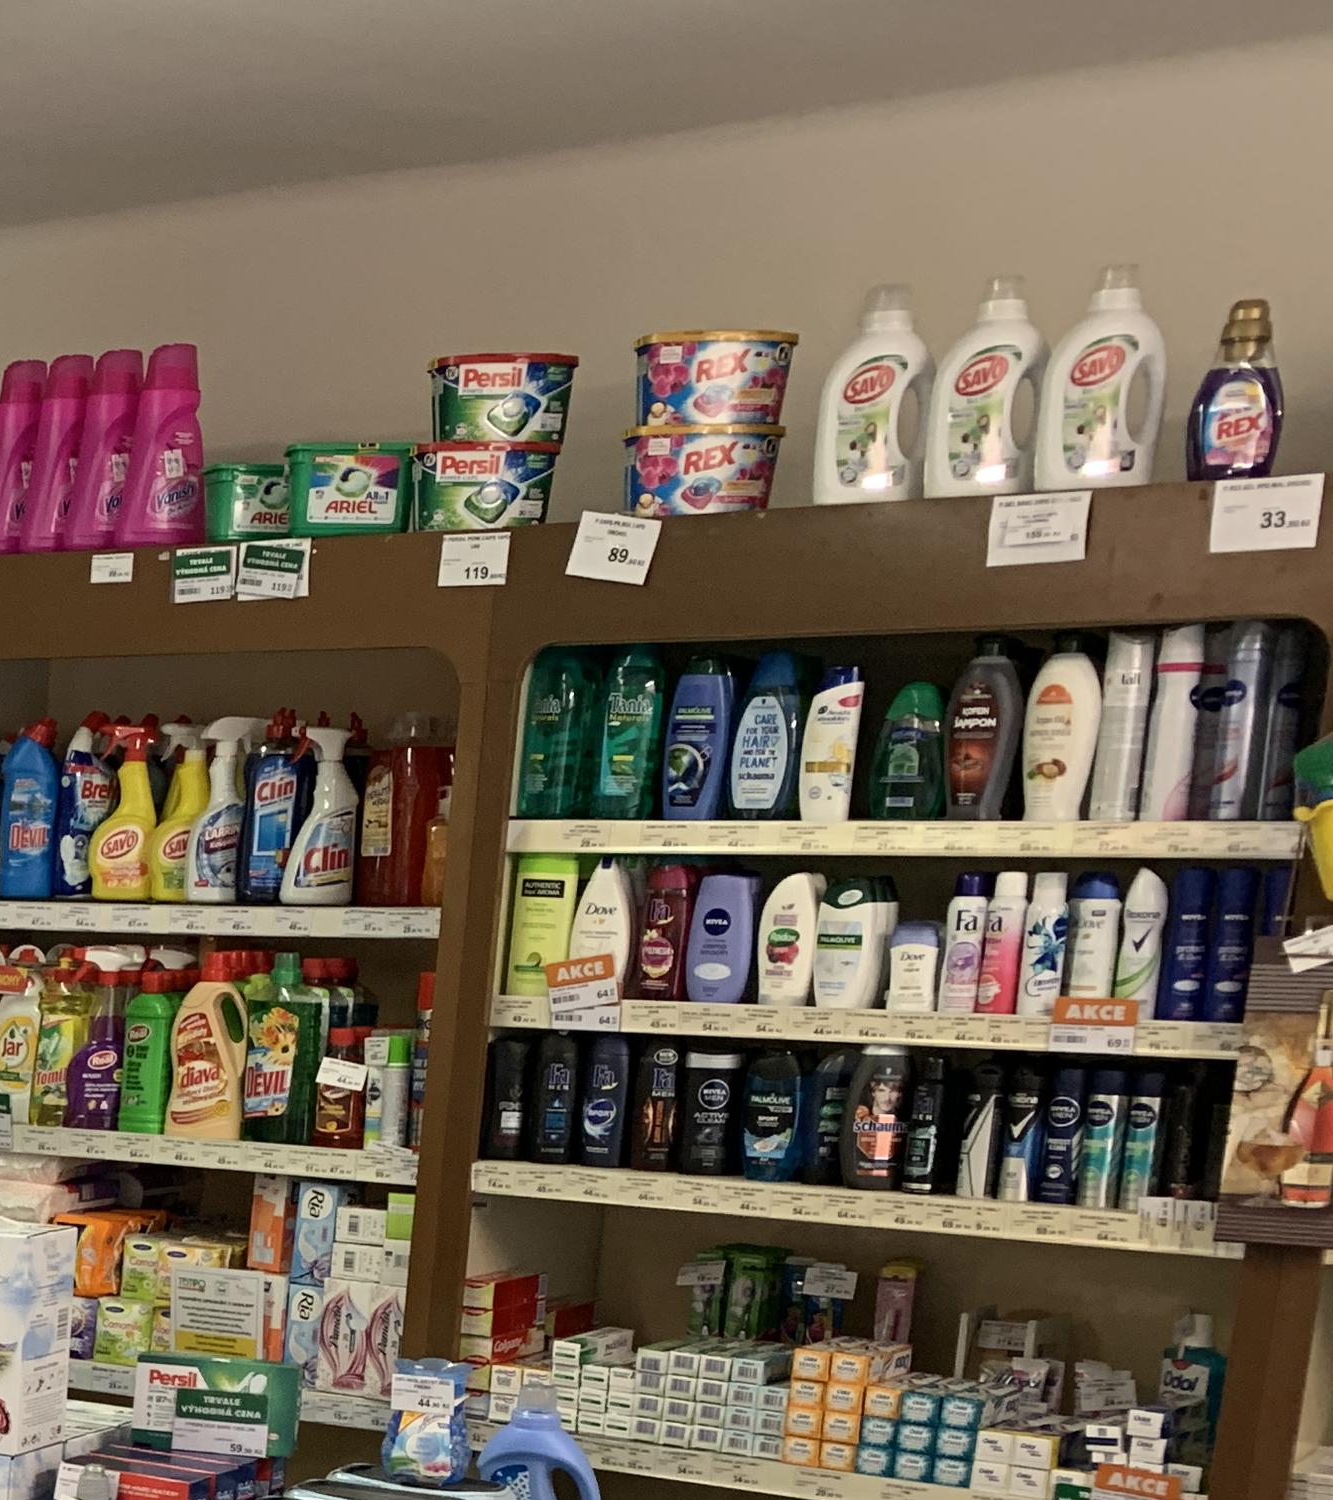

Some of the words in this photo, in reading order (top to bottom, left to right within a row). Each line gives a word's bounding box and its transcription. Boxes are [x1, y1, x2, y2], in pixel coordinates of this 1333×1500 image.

[696, 349, 751, 382] REX
[1079, 349, 1120, 379] SAVO
[463, 366, 523, 389] Persil
[852, 369, 889, 397] SAVO
[963, 361, 1003, 389] SAVO
[1217, 412, 1263, 440] REX
[440, 455, 501, 476] Persil
[683, 441, 739, 475] REX
[157, 480, 198, 505] Vanish
[324, 499, 378, 515] ARIEL
[250, 511, 289, 526] ARIE
[609, 692, 651, 713] Tania
[754, 714, 777, 725] CARE
[741, 736, 769, 748] HAIR
[739, 756, 778, 768] PLANET
[738, 772, 775, 781] schauma
[257, 776, 295, 802] Clin
[104, 832, 138, 853] SAVO
[167, 831, 190, 853] SAV
[304, 843, 349, 874] Clin
[524, 881, 562, 890] AUTHENTIC
[585, 902, 617, 917] Dove
[651, 899, 671, 920] Fa
[705, 918, 729, 926] NIVEA
[955, 909, 978, 934] Fa
[900, 951, 926, 962] Dove
[558, 961, 605, 983] AKCE
[1064, 1004, 1125, 1021] AKCE
[0, 1037, 24, 1057] Jar
[180, 1063, 220, 1089] diava
[245, 1065, 287, 1098] DEVIL
[853, 1119, 908, 1134] schauma
[307, 1189, 326, 1220] Ria
[299, 1292, 314, 1321] Ria
[149, 1369, 197, 1388] Persil
[234, 1407, 262, 1419] CENA
[1107, 1471, 1168, 1495] AKCE
